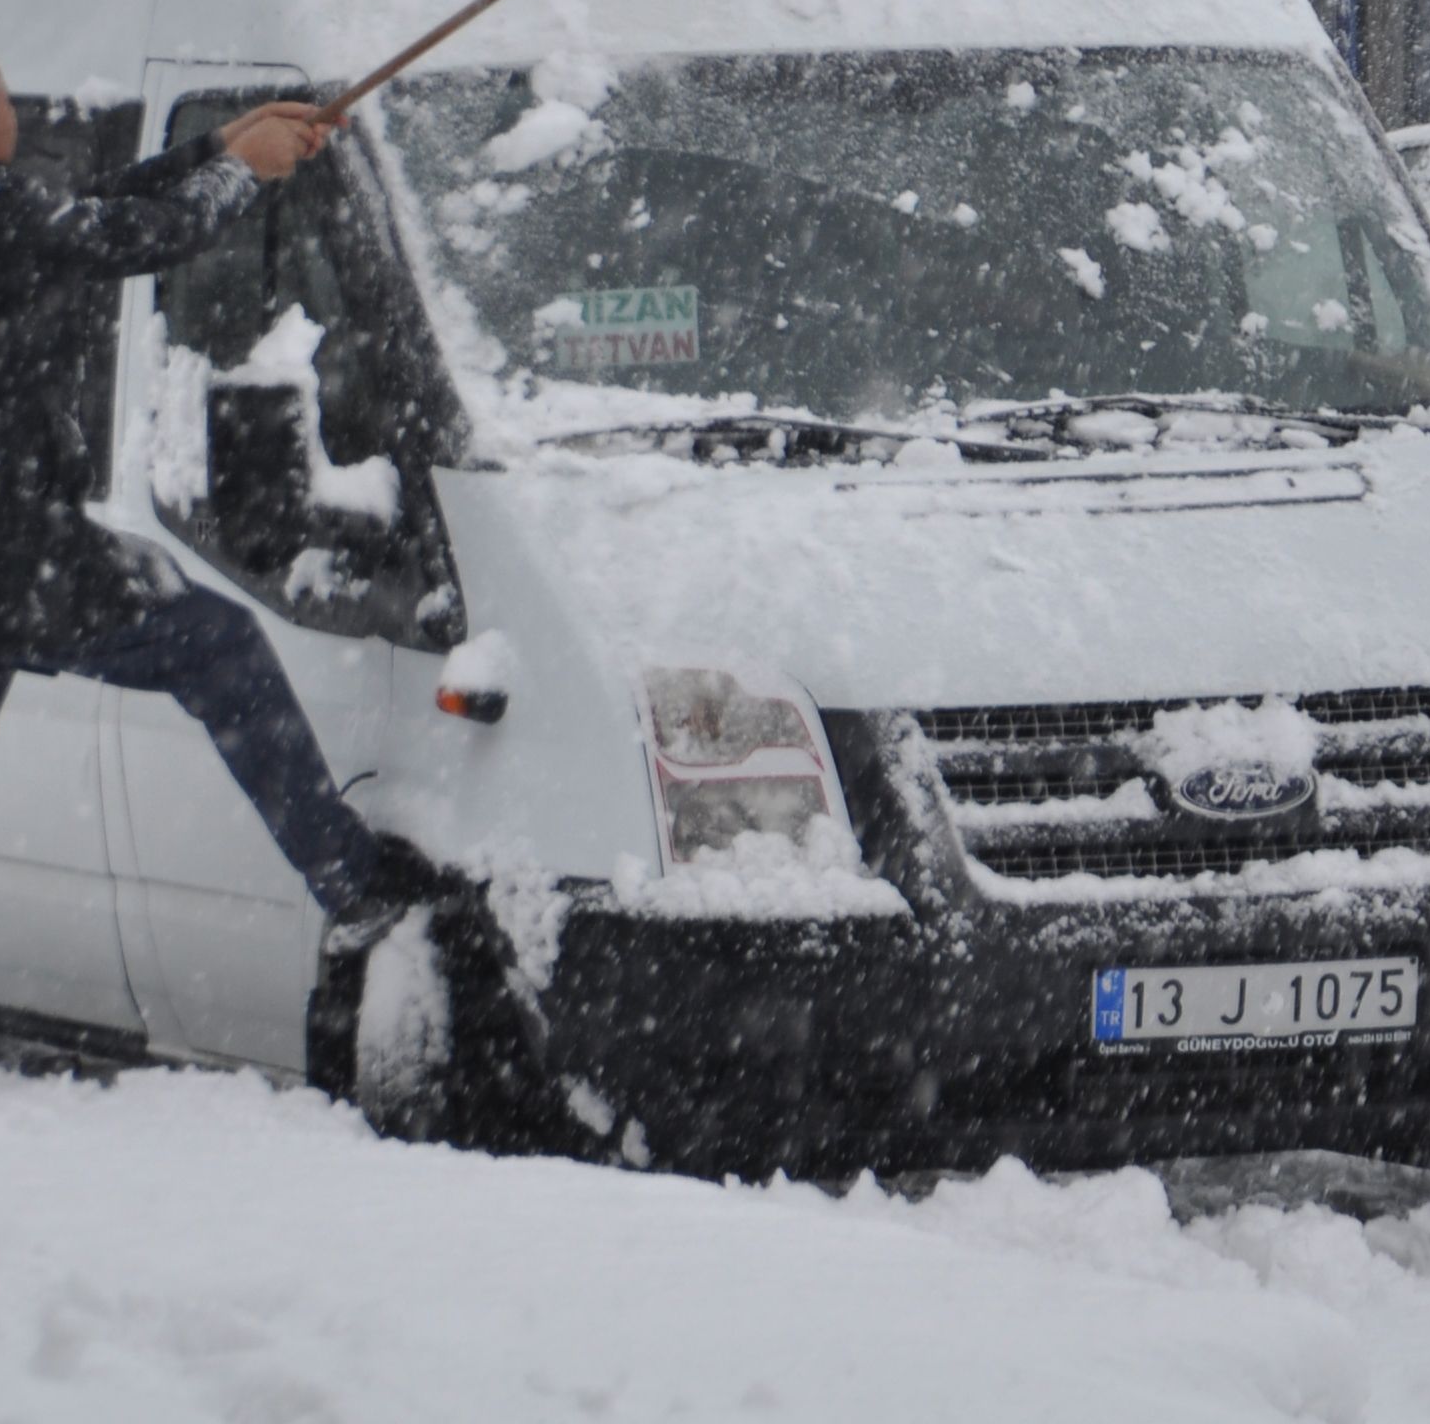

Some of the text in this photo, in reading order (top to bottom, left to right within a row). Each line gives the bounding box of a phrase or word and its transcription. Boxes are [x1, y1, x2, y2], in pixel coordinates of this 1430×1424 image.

[1208, 767, 1284, 806] Ford
[1131, 978, 1184, 1029] 13
[1220, 978, 1248, 1026] J
[1289, 968, 1405, 1024] 1075
[1302, 1031, 1338, 1048] OTO
